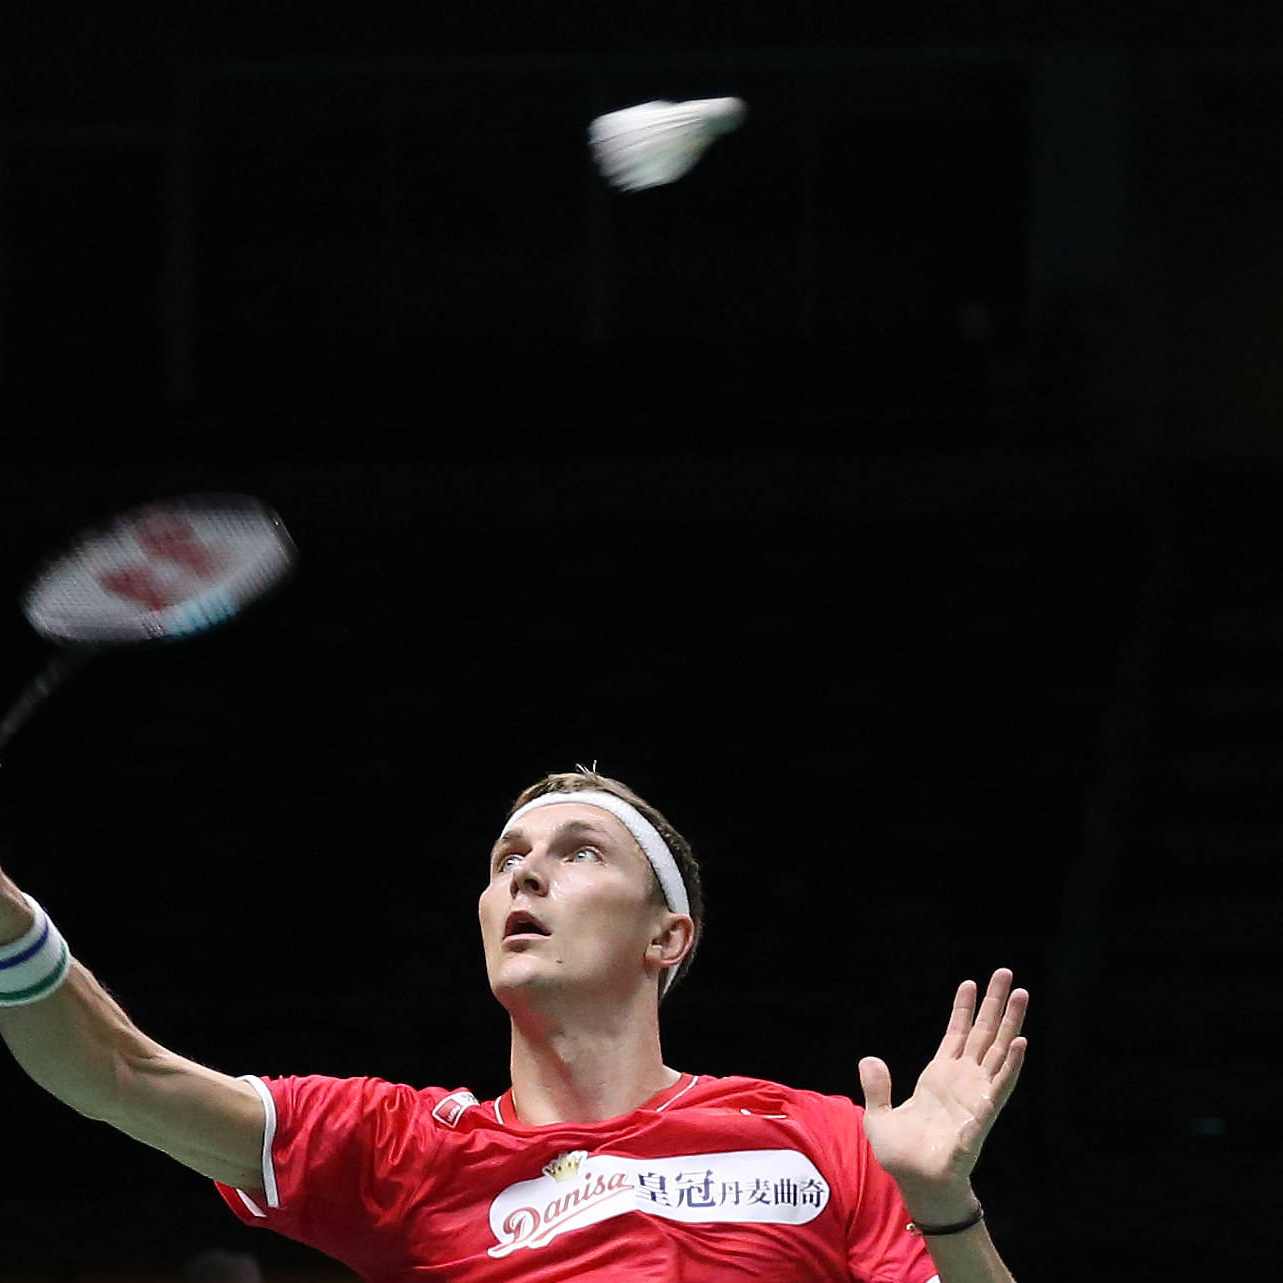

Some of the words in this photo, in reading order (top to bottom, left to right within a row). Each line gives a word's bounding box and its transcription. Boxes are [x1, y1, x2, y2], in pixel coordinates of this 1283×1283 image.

[493, 1170, 633, 1248] Danisa
[634, 1169, 825, 1209] 皇冠丹麦曲奇
